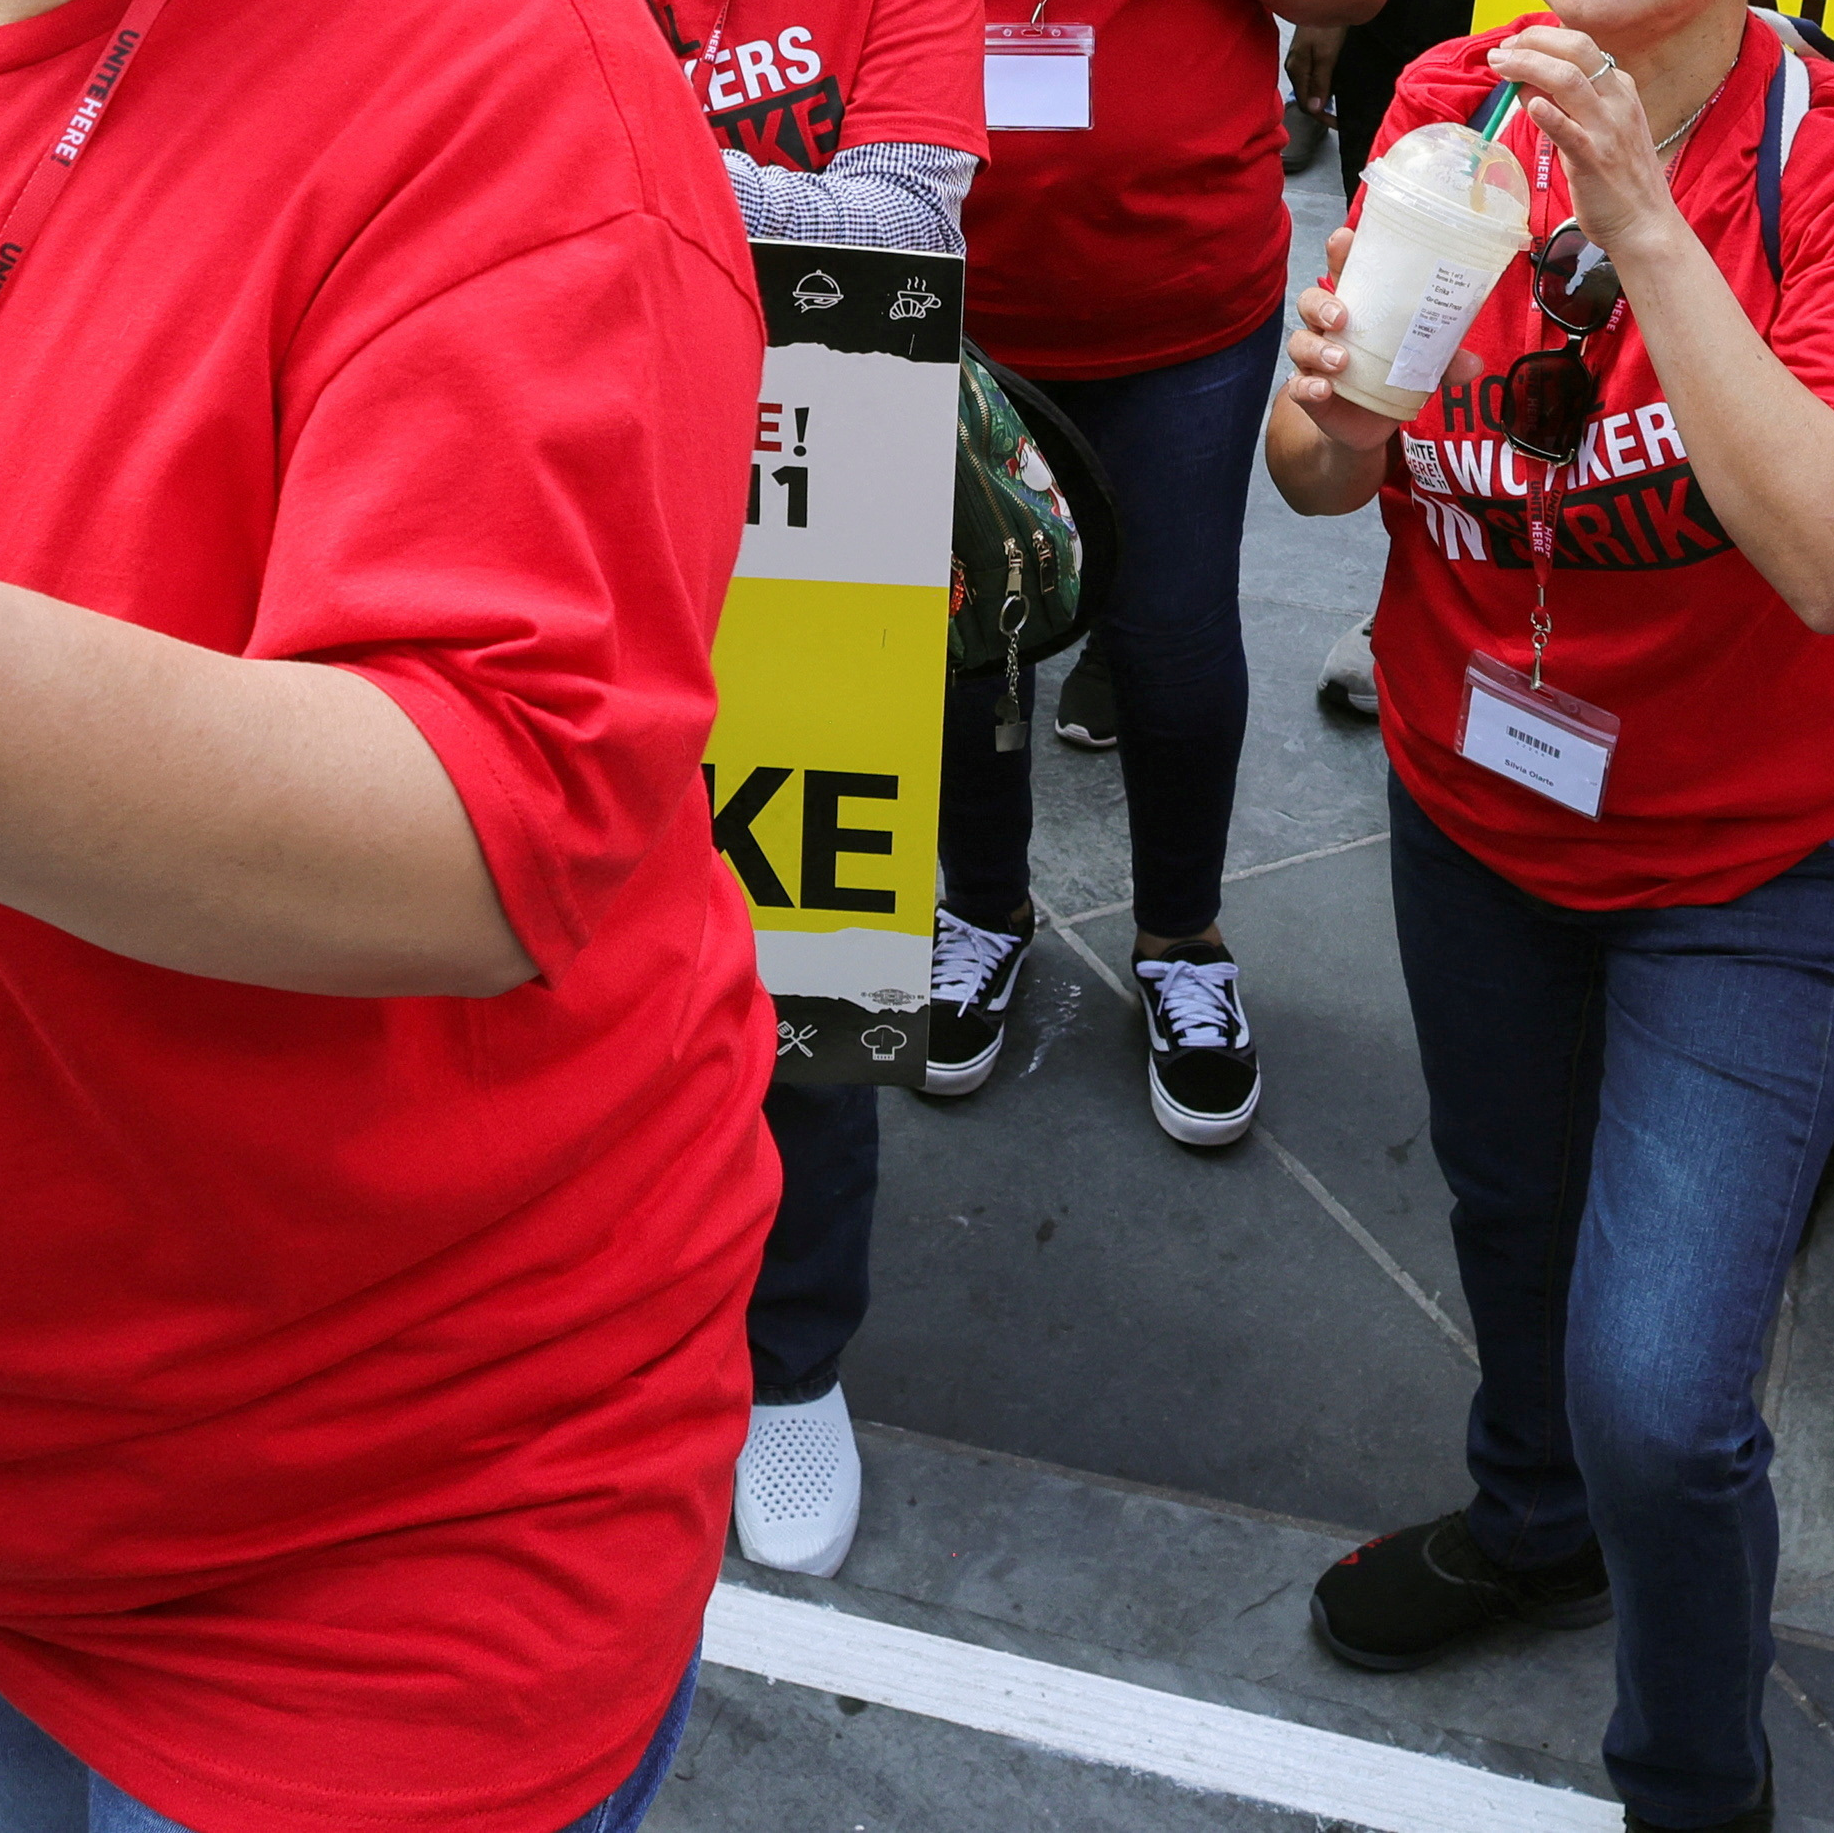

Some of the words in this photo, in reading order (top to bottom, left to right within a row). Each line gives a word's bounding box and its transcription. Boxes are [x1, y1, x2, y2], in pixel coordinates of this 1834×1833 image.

[86, 28, 141, 102] UNITE
[50, 94, 106, 168] HERE!
[1435, 286, 1449, 295] Erika
[1504, 759, 1527, 774] Silvia
[1529, 770, 1554, 787] Olarte
